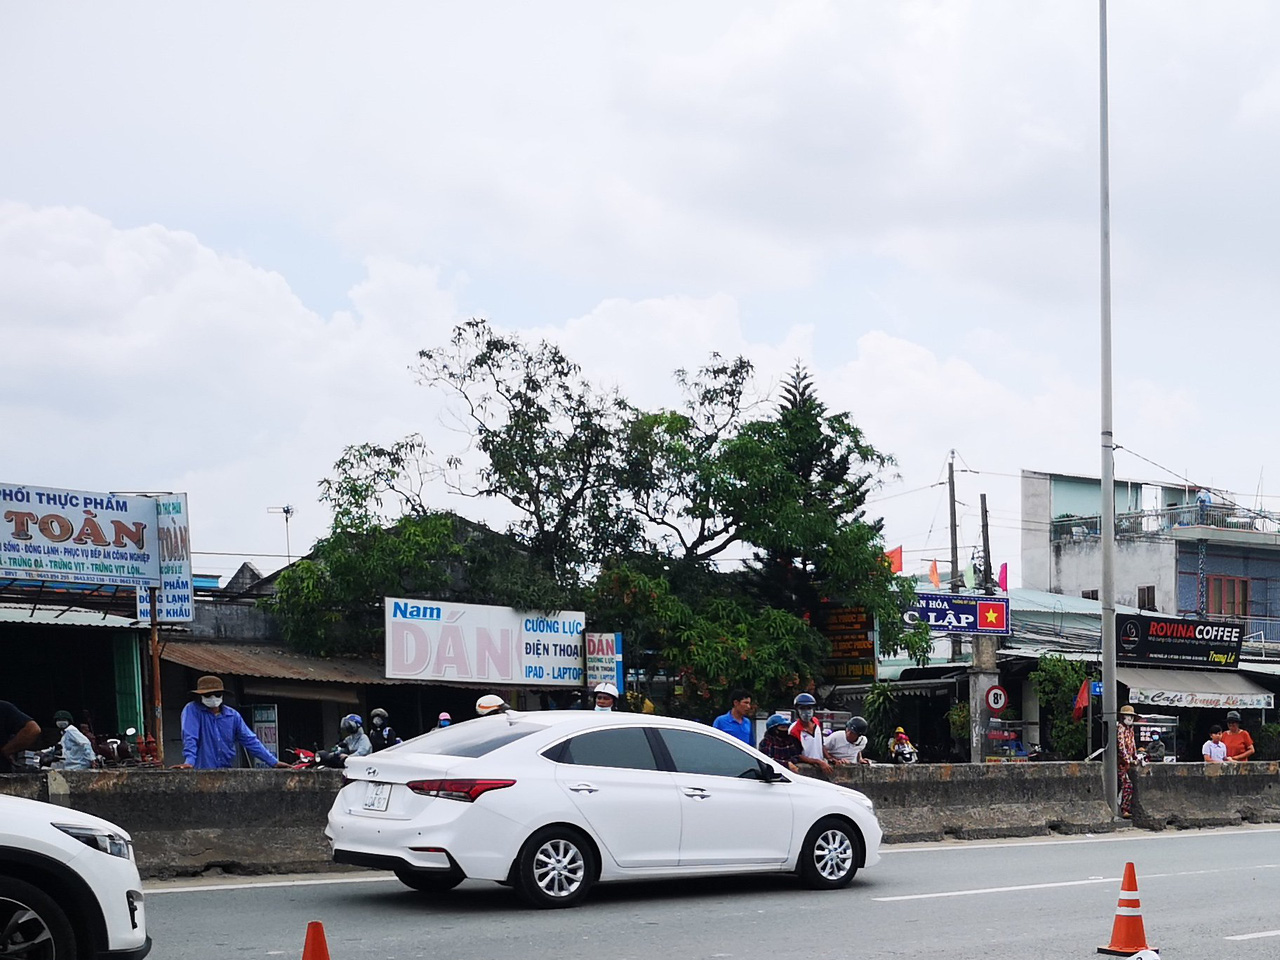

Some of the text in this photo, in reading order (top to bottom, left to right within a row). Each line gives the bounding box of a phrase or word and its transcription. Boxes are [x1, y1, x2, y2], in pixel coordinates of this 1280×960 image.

[0, 486, 128, 513] HỐI THỰC PHẨM
[4, 510, 147, 550] TOÀN
[3, 541, 20, 553] SỐNG
[43, 544, 60, 557] LẠNH
[63, 547, 80, 560] PHỤC
[112, 549, 128, 561] CÔNG
[164, 576, 189, 591] PHẨM
[138, 593, 190, 606] ĐÔG LẠNH
[928, 598, 950, 609] HÓA
[139, 603, 191, 618] NHP KHẨU
[392, 601, 442, 620] Nam
[927, 610, 975, 630] LẬP
[524, 616, 583, 637] CƯỜNG LỰC
[391, 610, 514, 681] DÁN
[524, 641, 583, 661] ĐIỆN THOẠI
[587, 633, 615, 656] DÁN
[524, 665, 583, 680] IPAD LAPTOP
